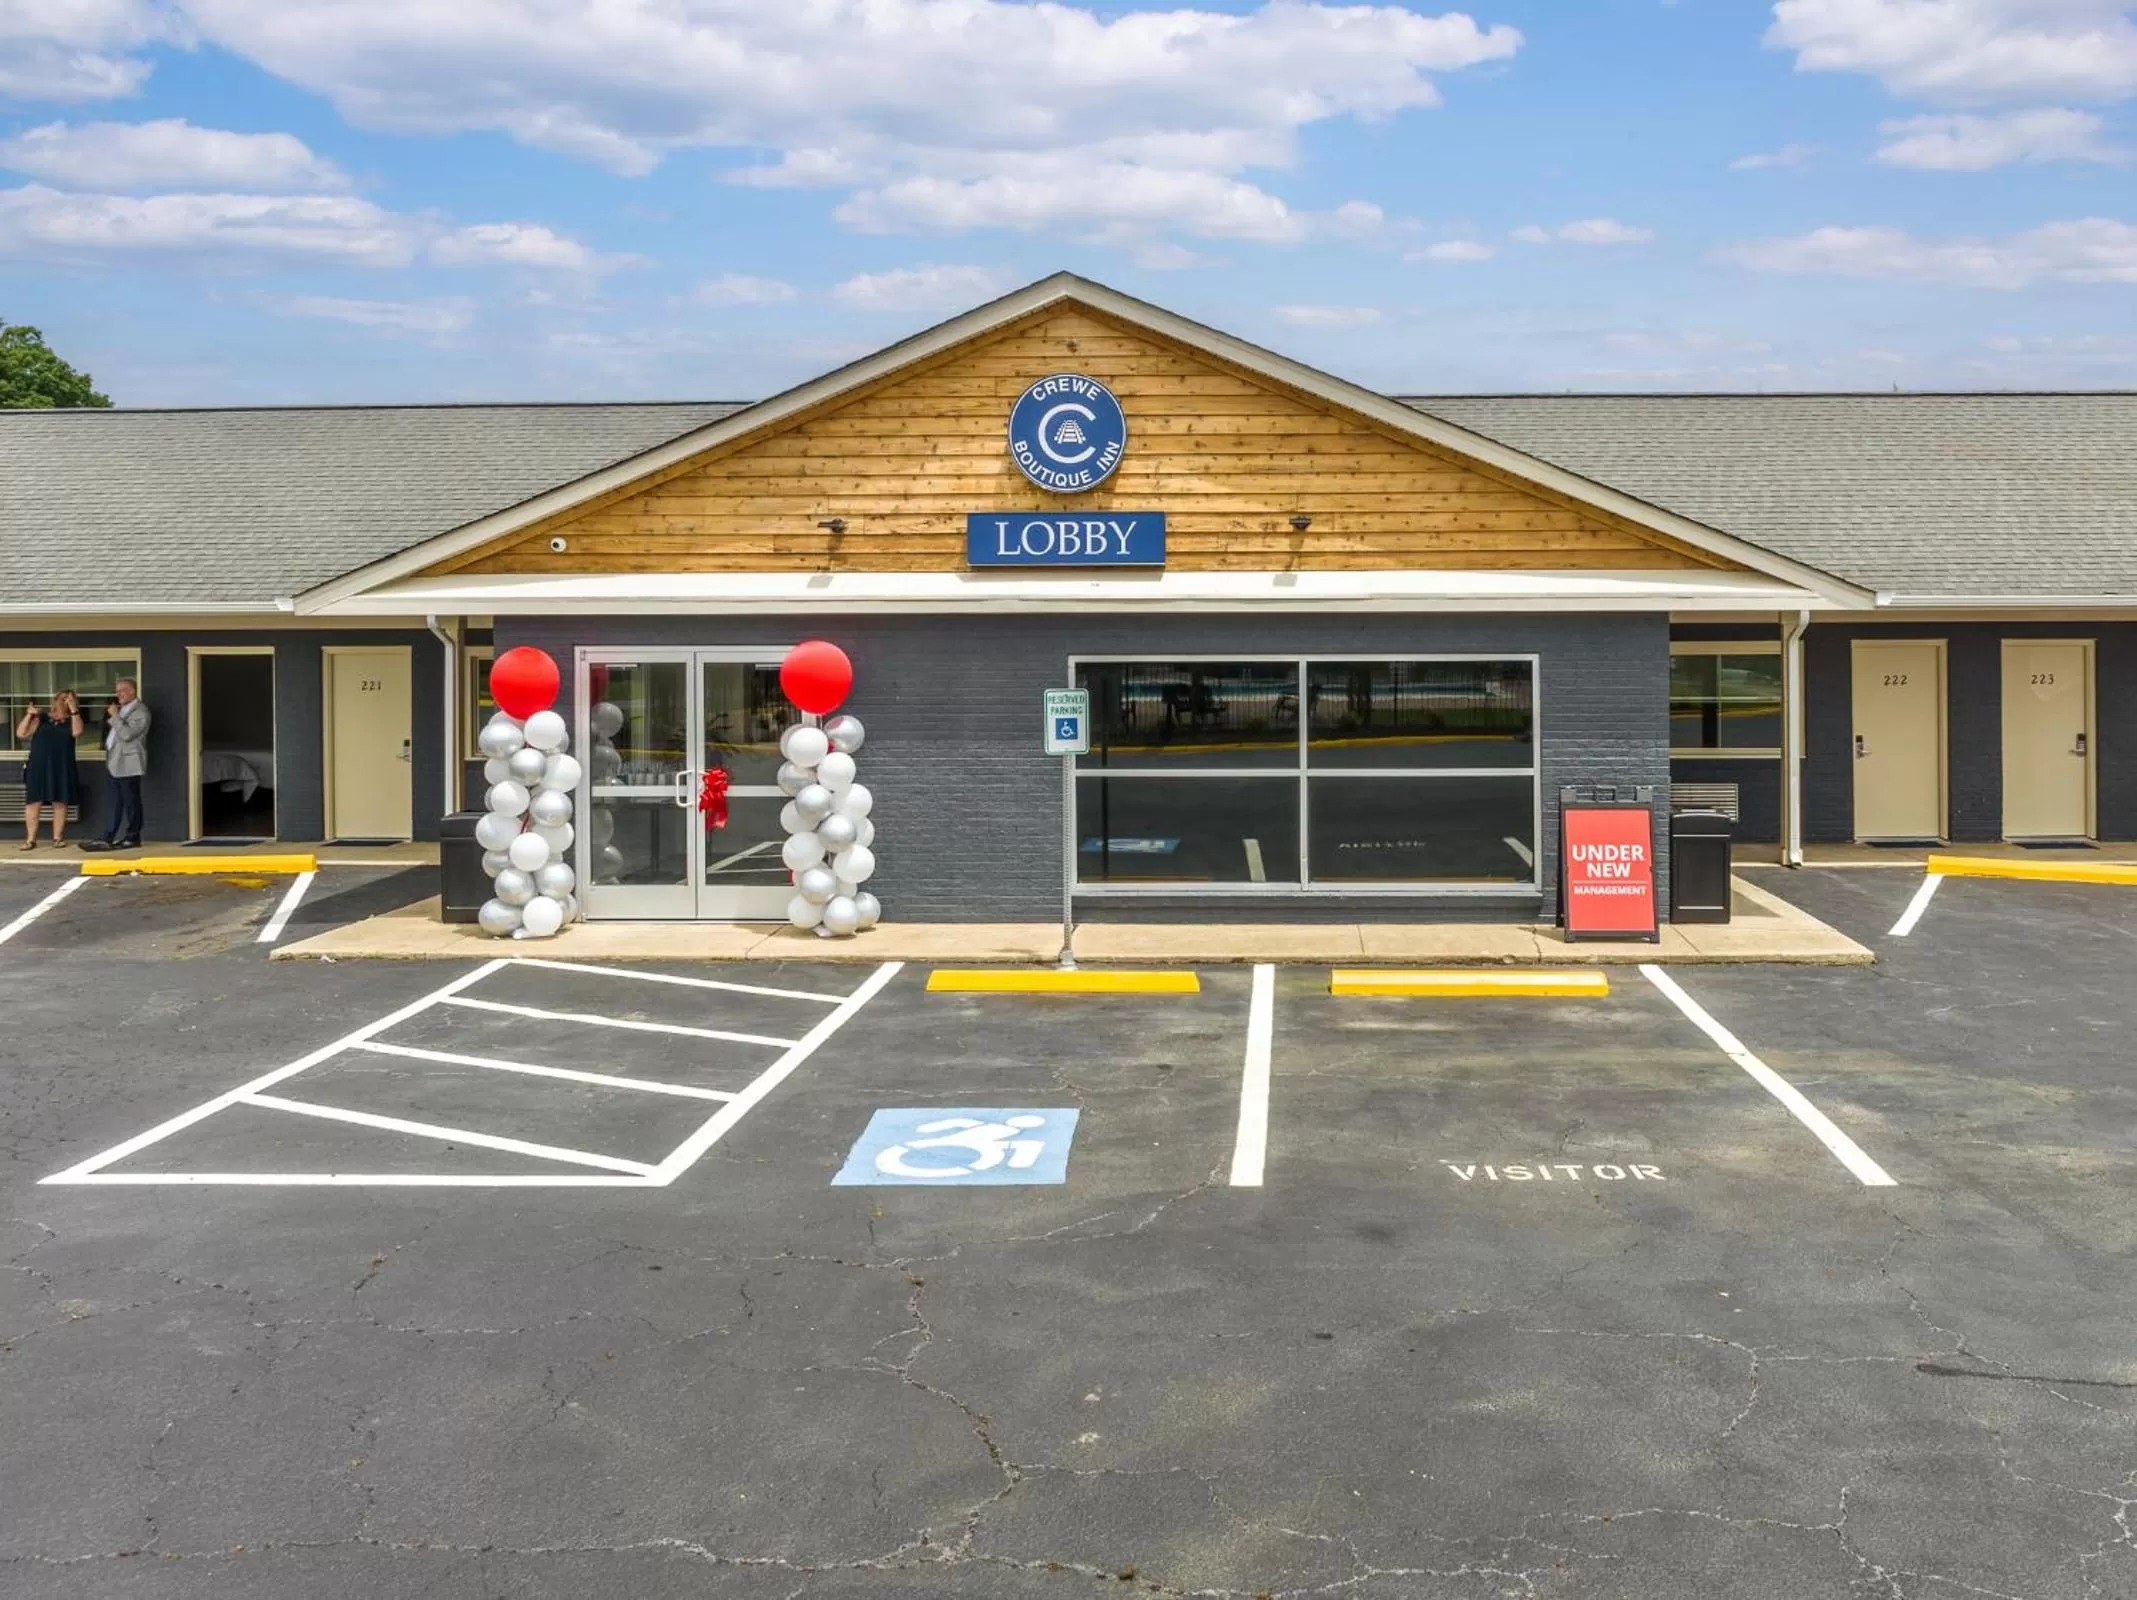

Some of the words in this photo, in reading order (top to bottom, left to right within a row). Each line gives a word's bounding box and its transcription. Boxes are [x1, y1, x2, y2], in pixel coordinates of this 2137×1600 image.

[1032, 378, 1101, 401] CREWE
[1038, 403, 1097, 464] C
[1014, 440, 1093, 487] BOUTIQUE
[1096, 441, 1121, 471] INN
[994, 521, 1138, 556] LOBBY
[361, 680, 382, 691] 221
[1884, 674, 1907, 686] 222
[2031, 673, 2054, 685] 223
[1047, 694, 1085, 704] RESERVED
[1050, 706, 1083, 715] PARKING
[1571, 844, 1645, 861] UNDER
[1586, 862, 1632, 878] NEW
[1573, 885, 1647, 896] MANAGEMENT
[1447, 1164, 1666, 1181] VISITOR
